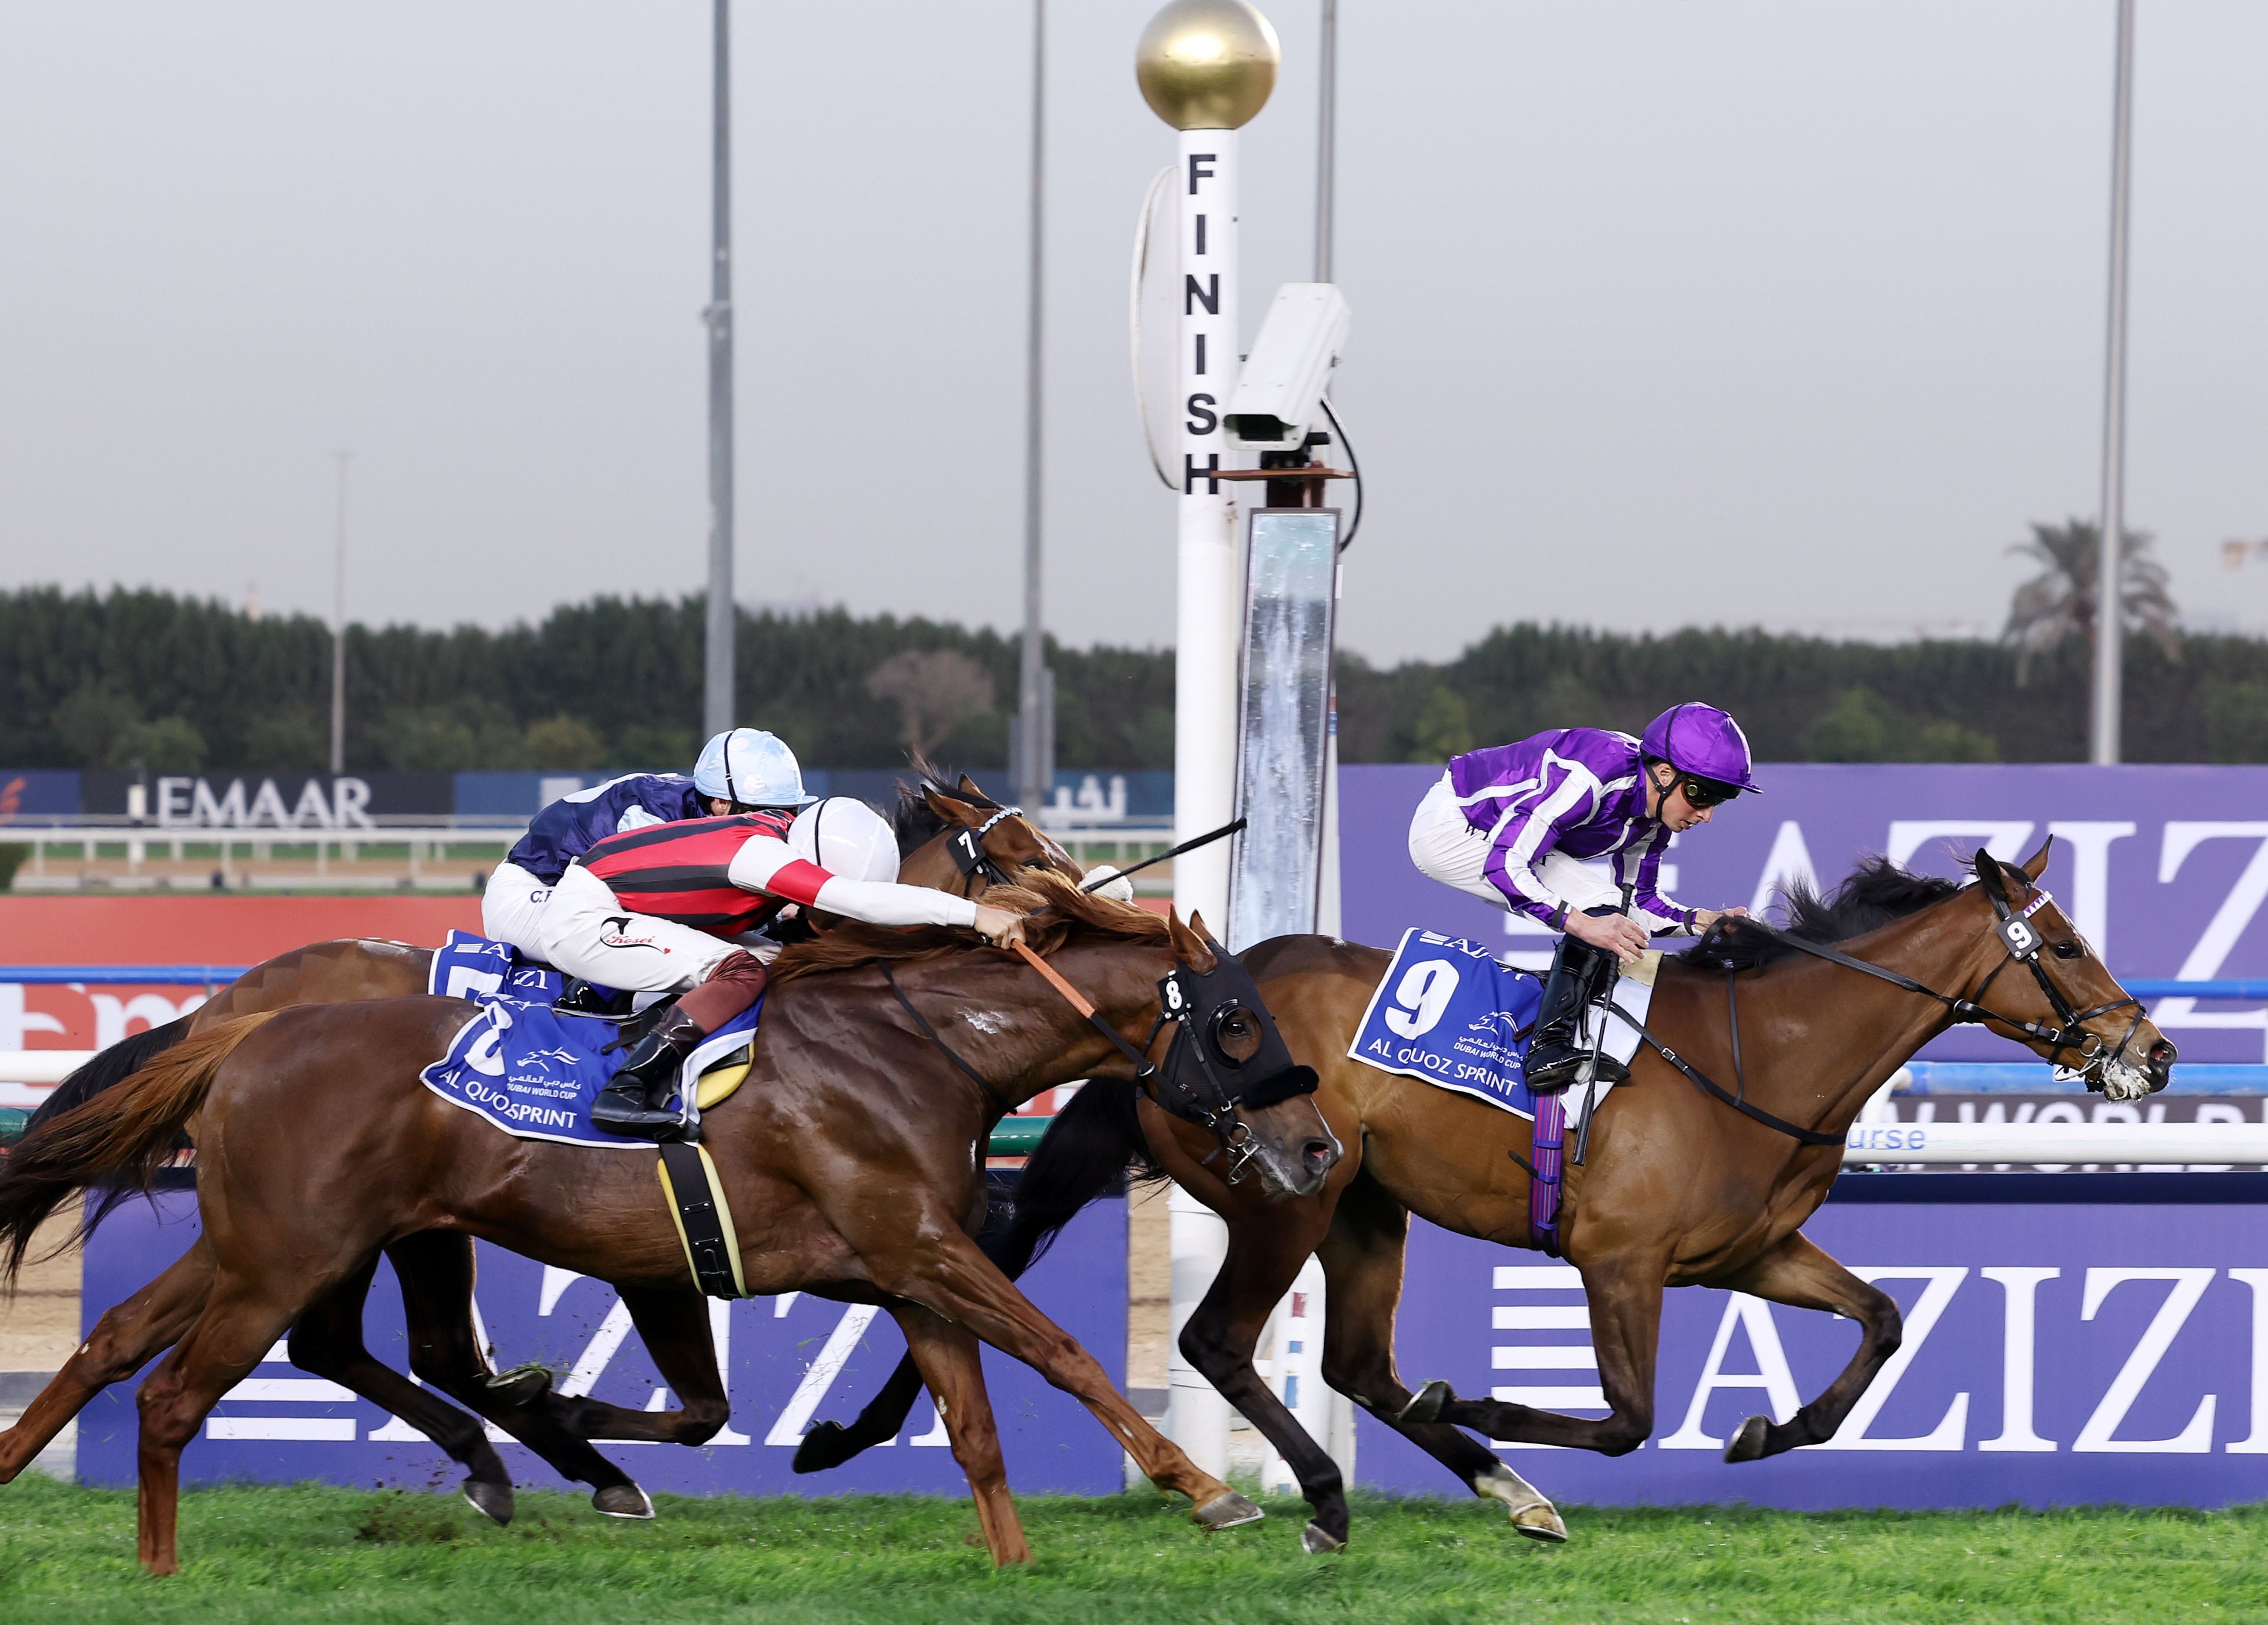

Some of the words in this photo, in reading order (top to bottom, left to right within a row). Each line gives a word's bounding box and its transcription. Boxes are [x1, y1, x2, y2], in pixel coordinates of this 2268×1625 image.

[1184, 154, 1220, 495] FINISH
[157, 776, 375, 828] EMAAR
[957, 830, 977, 860] 7
[2006, 921, 2033, 950] 9
[1165, 980, 1183, 1010] 8
[1383, 958, 1461, 1041] 9
[1368, 1037, 1392, 1058] AL
[1397, 1047, 1453, 1074] QUOZ
[1454, 1063, 1518, 1096] SPRINT
[1453, 1041, 1480, 1056] DUBAI
[1480, 1050, 1505, 1064] WORLD
[1504, 1059, 1521, 1070] CUP
[439, 1070, 461, 1090] AL
[531, 1087, 559, 1098] WORLD
[559, 1090, 578, 1100] CUP
